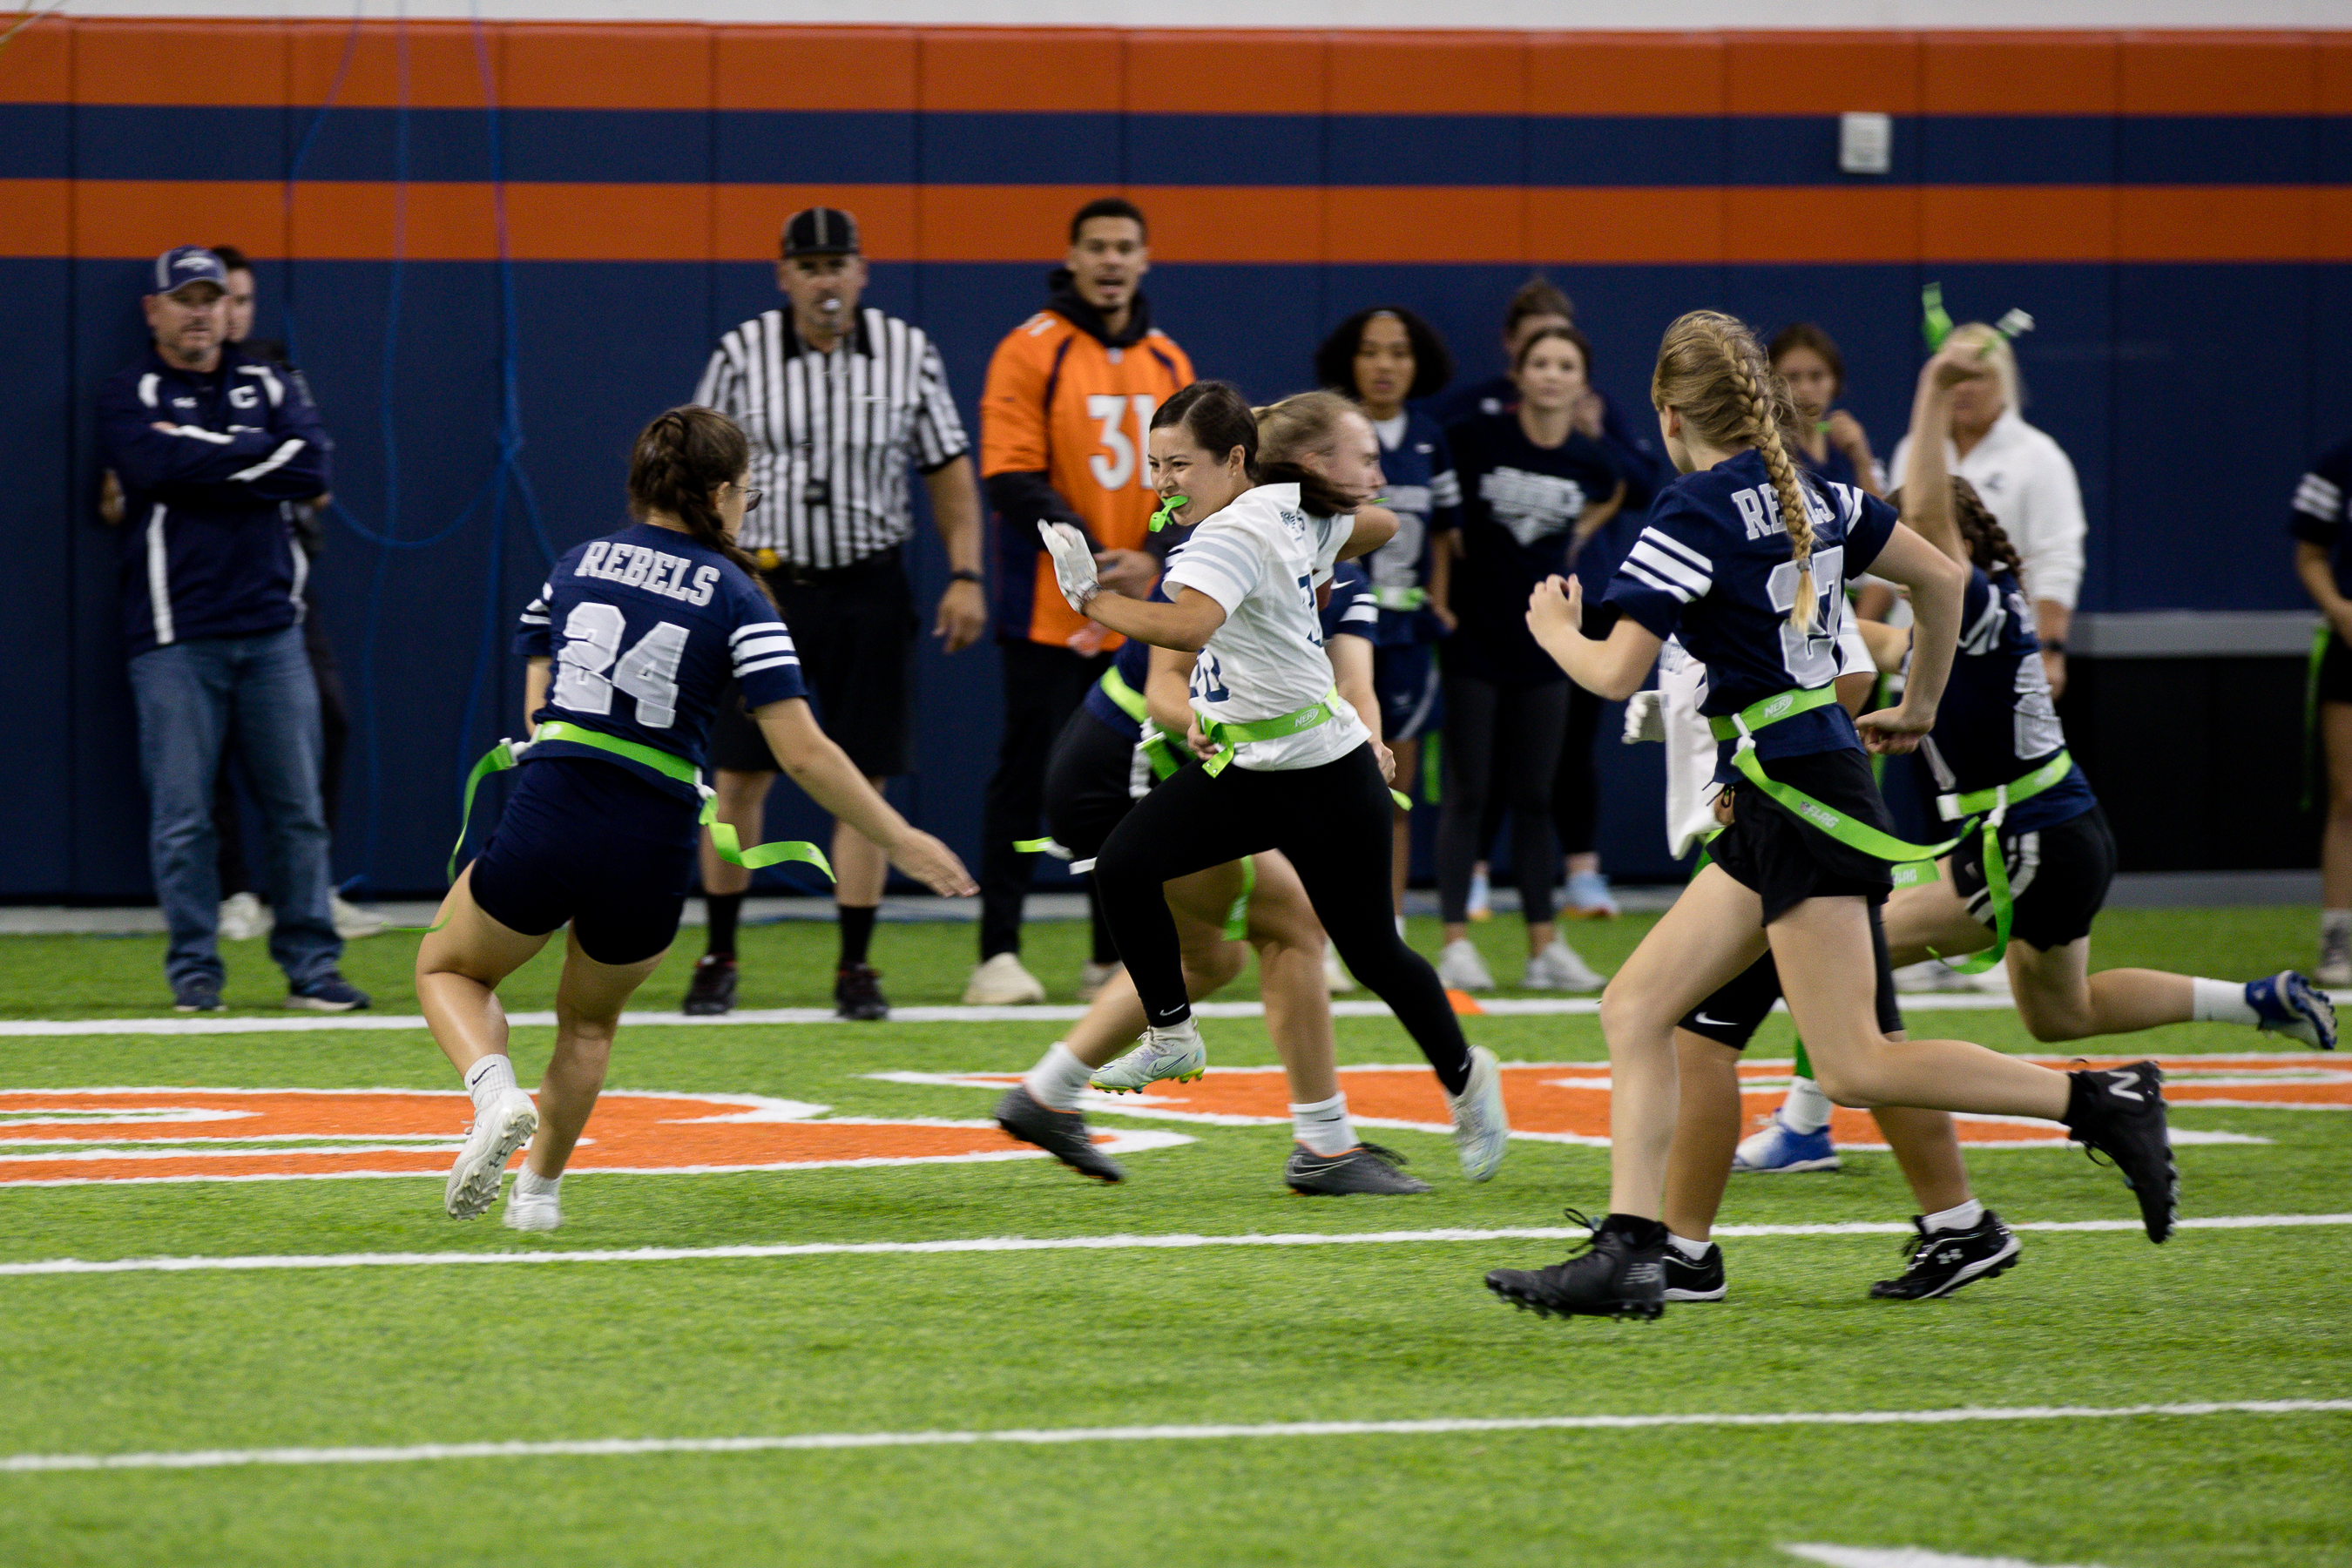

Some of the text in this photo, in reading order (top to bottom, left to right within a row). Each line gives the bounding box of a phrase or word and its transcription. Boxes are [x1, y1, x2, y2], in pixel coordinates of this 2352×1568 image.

[574, 541, 720, 607] REBELS
[1766, 545, 1848, 689] 27
[551, 601, 691, 728] 24
